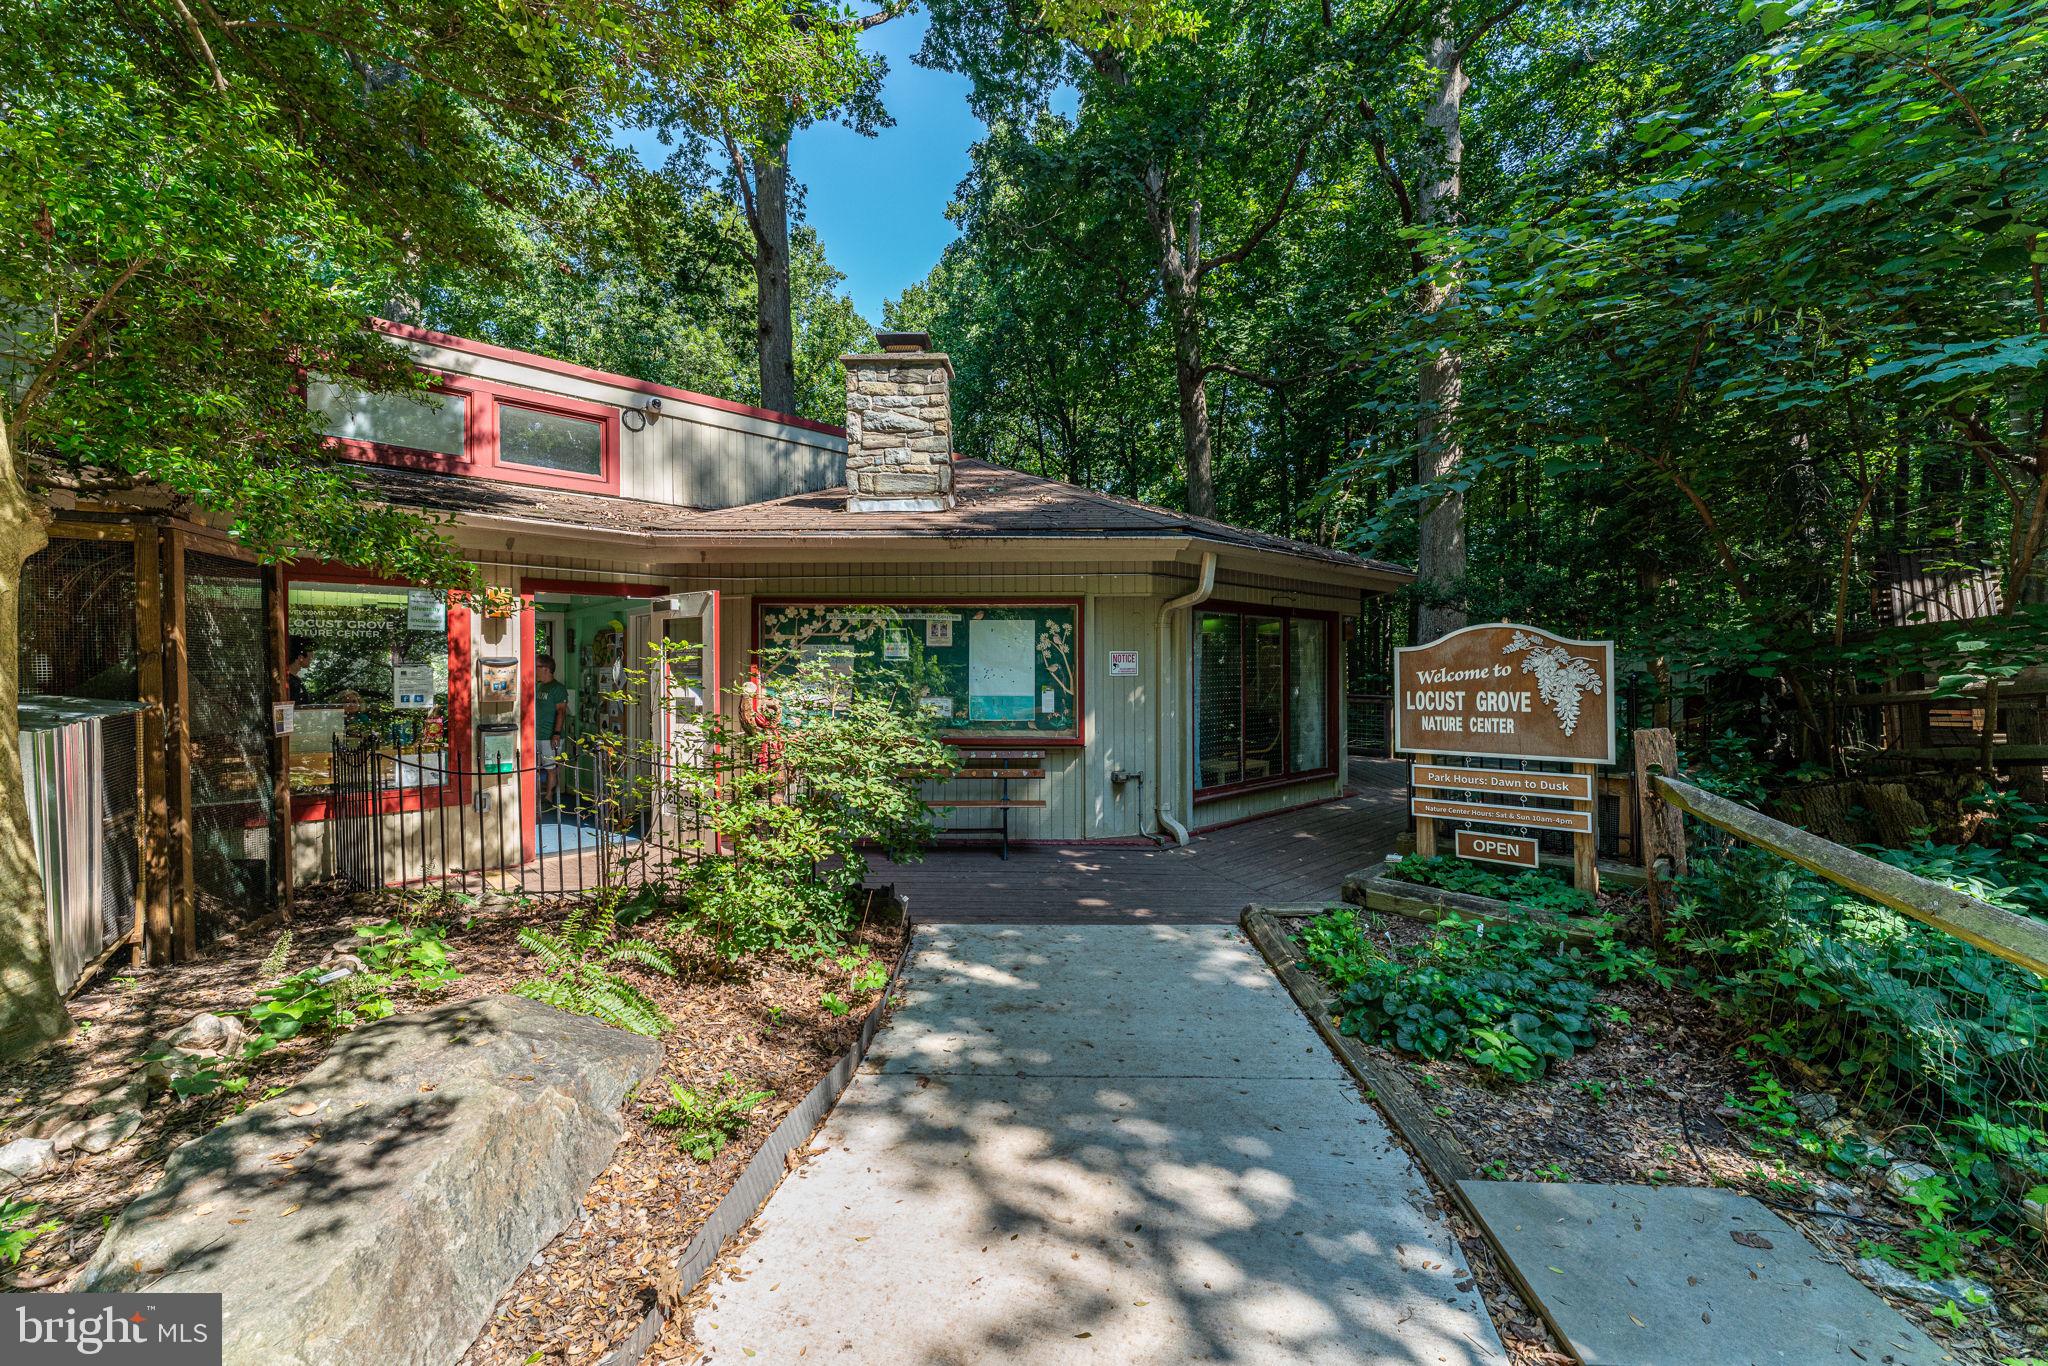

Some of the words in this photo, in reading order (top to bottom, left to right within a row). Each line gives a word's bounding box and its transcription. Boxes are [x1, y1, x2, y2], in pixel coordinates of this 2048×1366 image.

[336, 630, 380, 638] CENTER
[347, 620, 395, 630] GROVE
[1112, 654, 1136, 663] NOTICE
[1416, 666, 1489, 685] Welcome
[1492, 663, 1512, 677] to
[1406, 690, 1465, 711] LOCUST
[1476, 691, 1531, 712] GROVE
[1422, 715, 1463, 732] NATURE
[1469, 717, 1515, 733] CENTER
[1428, 772, 1451, 782] Park
[1454, 774, 1487, 785] Hours:
[1491, 777, 1521, 787] Dawn
[1525, 780, 1537, 789] to
[1540, 781, 1569, 791] Dusk
[1425, 805, 1447, 813] Nature
[1448, 807, 1469, 815] Center
[1471, 809, 1494, 817] Hours:
[1495, 811, 1508, 819] Sat
[1532, 815, 1573, 825] 10am-4pm
[1473, 839, 1520, 857] OPEN
